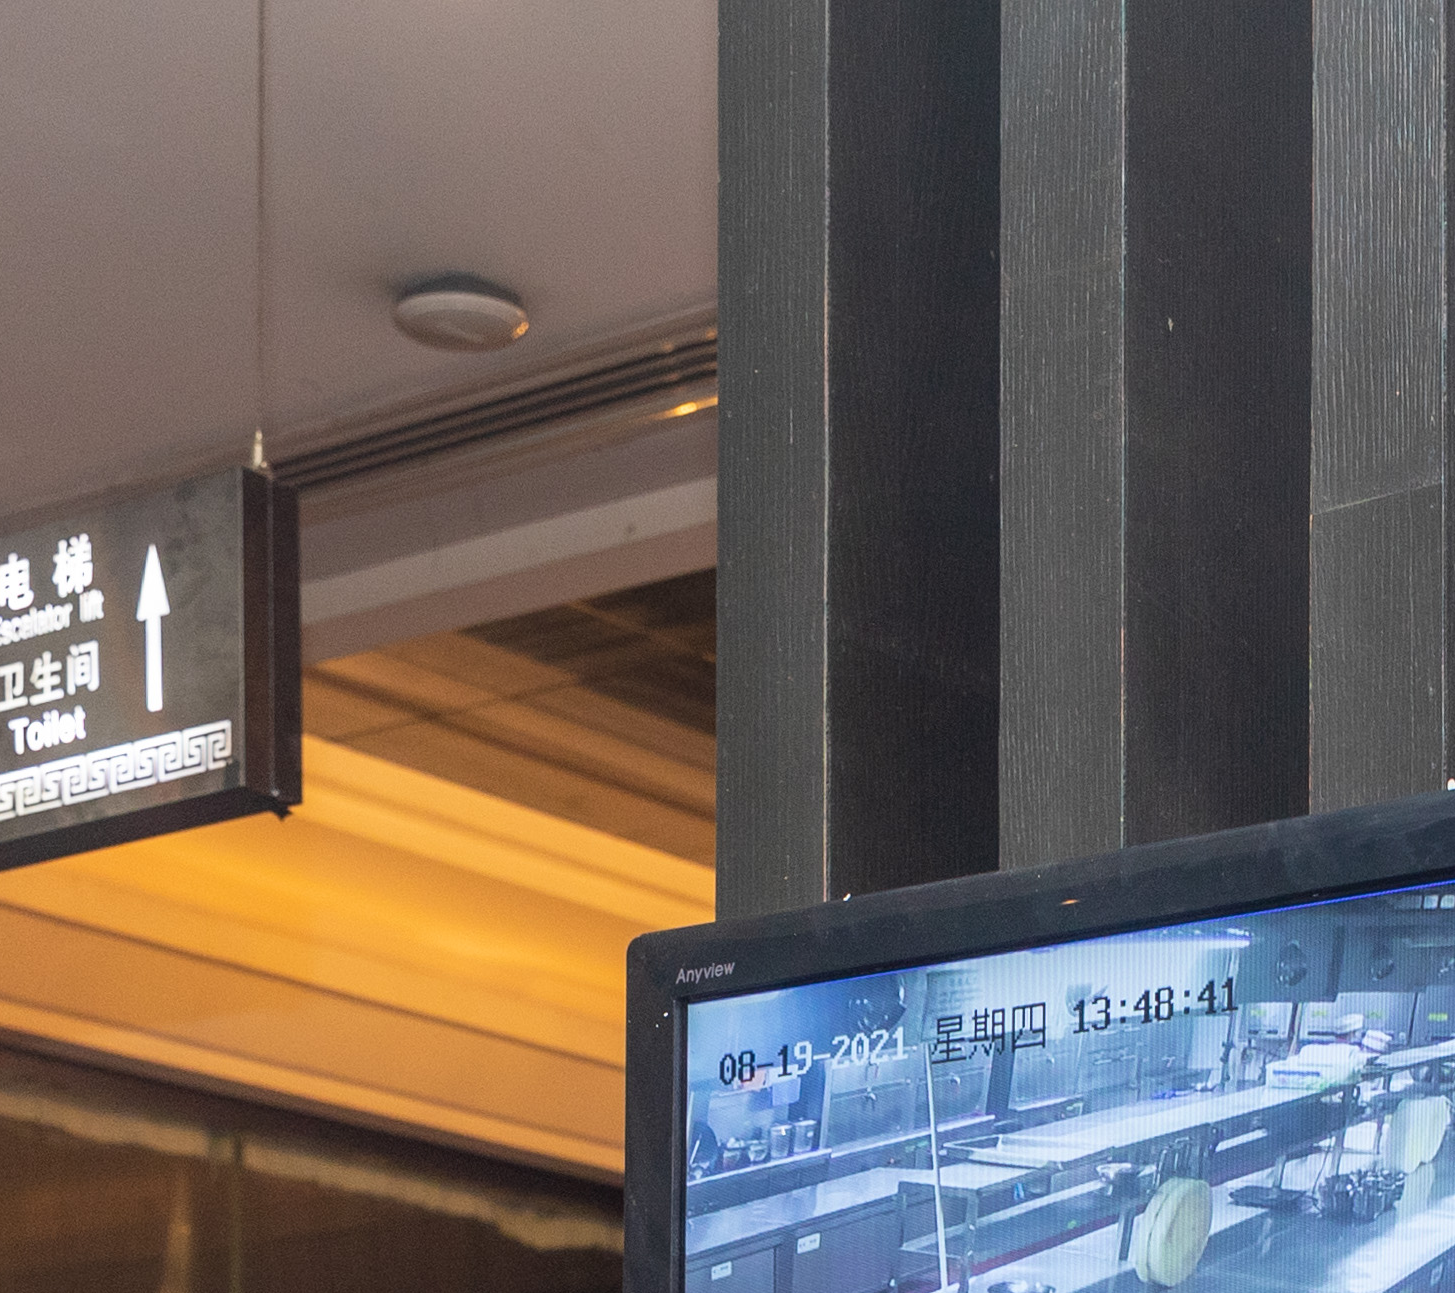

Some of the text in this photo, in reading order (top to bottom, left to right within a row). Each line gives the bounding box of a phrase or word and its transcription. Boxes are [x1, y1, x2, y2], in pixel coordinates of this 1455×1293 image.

[7, 705, 87, 755] Toilet
[676, 961, 736, 985] Anyview
[719, 978, 1238, 1085] 08-19-2021 星期四 13:48:41
